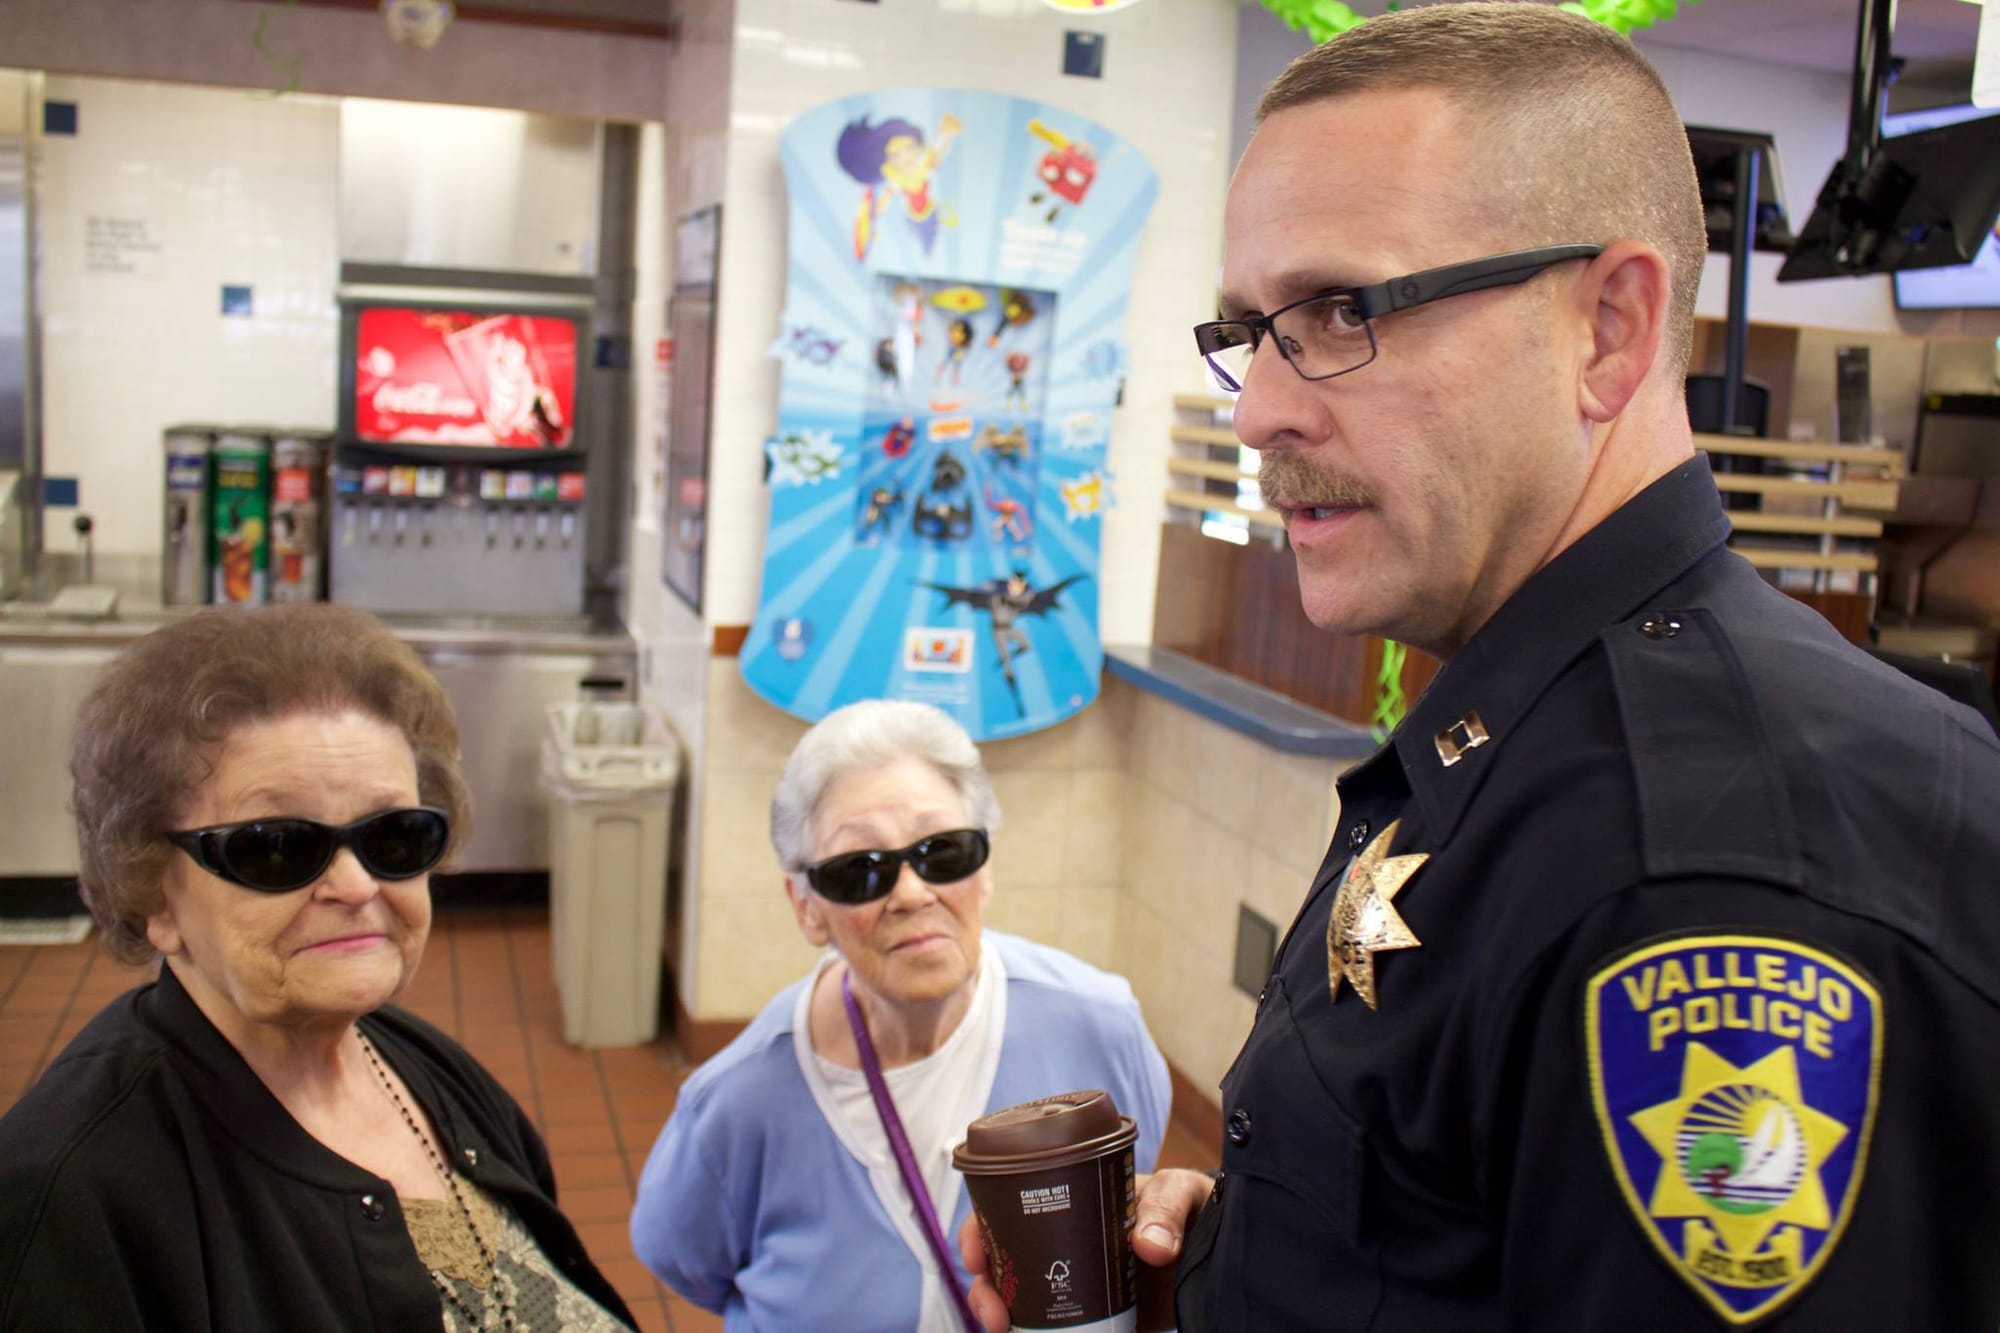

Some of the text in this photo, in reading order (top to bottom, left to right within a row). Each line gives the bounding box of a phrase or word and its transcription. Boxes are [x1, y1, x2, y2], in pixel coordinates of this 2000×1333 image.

[1622, 952, 1852, 1022] VALLEJO
[1648, 993, 1833, 1059] POLICE
[1020, 1188, 1051, 1200] CAUTION
